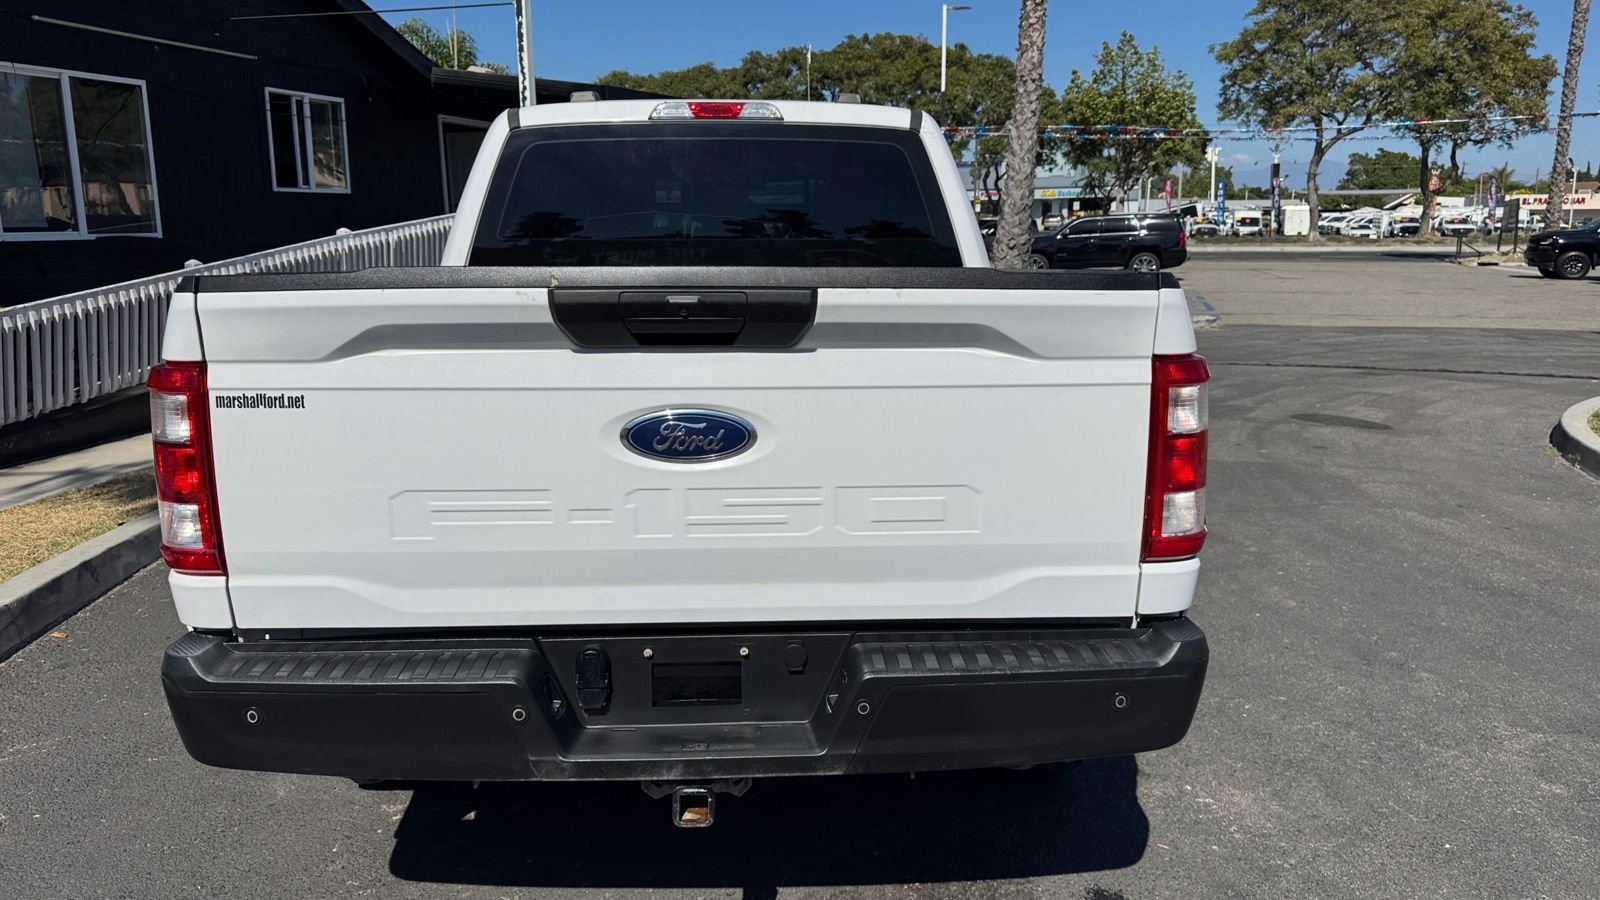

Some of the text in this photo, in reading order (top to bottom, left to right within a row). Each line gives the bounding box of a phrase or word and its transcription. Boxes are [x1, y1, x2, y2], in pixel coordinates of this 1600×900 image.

[215, 393, 305, 409] marshallford.net
[652, 420, 725, 452] Ford
[388, 483, 983, 543] F-150
